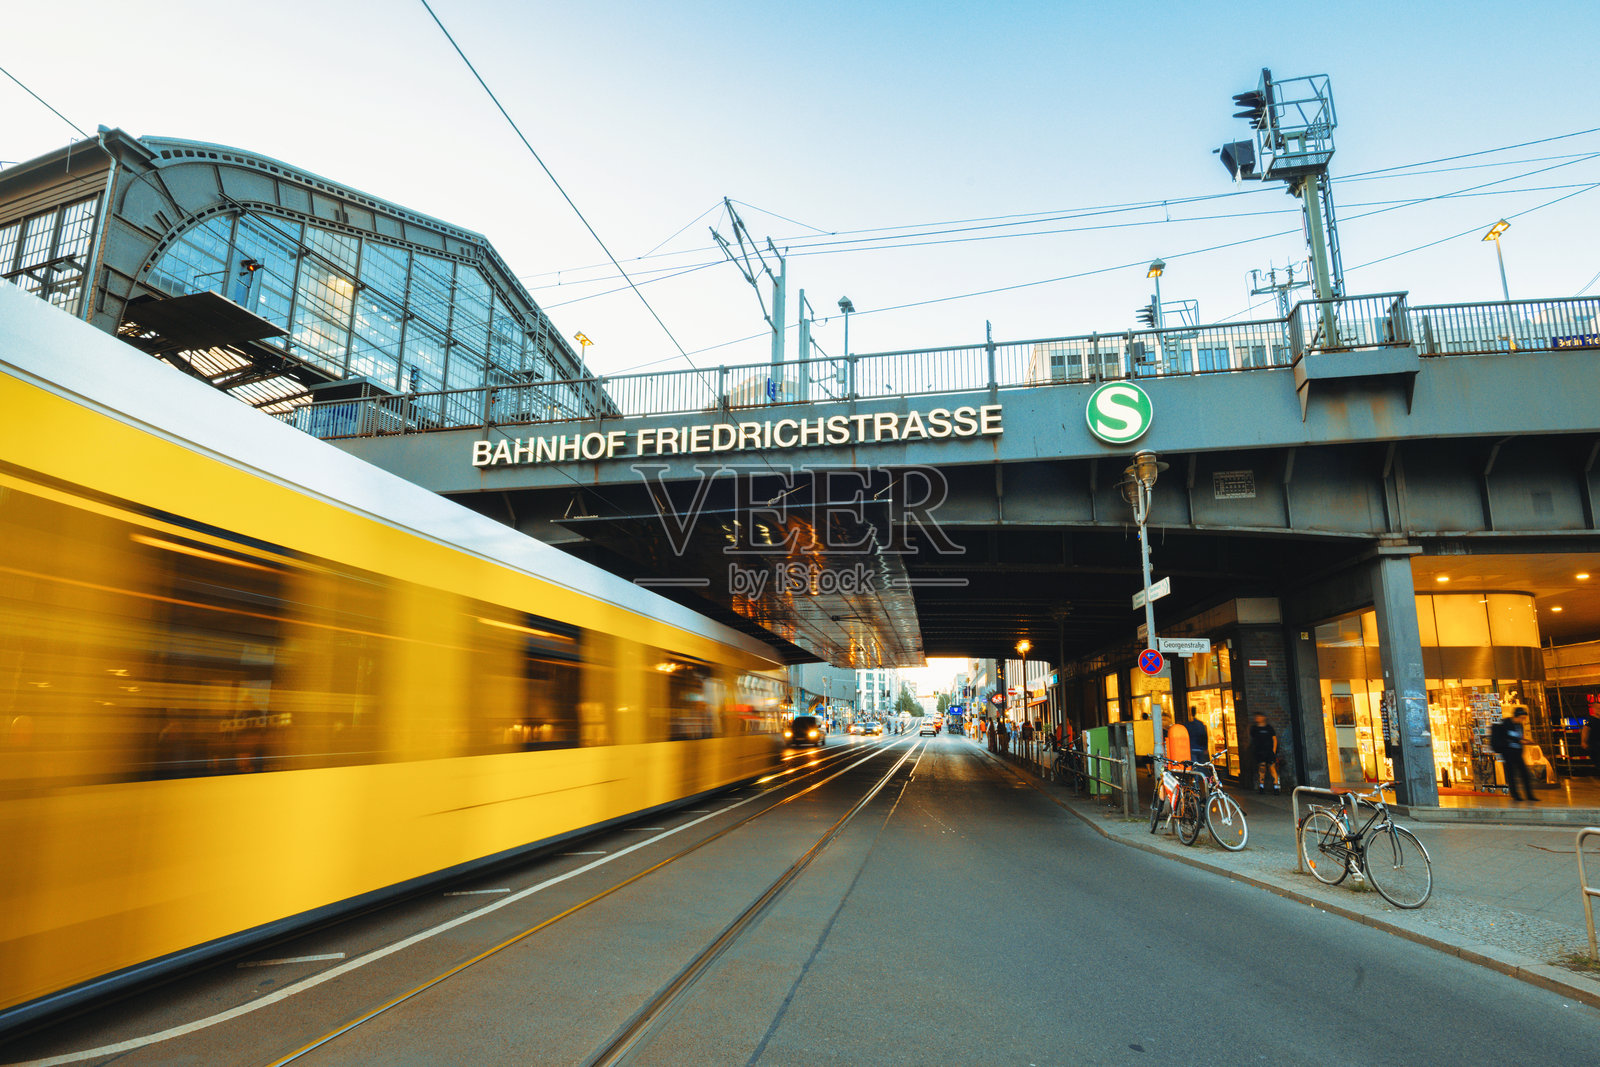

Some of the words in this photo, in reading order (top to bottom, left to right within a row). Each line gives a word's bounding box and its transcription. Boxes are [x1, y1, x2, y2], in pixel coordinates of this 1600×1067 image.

[1559, 338, 1583, 348] Berin
[1096, 386, 1143, 438] S
[472, 430, 627, 467] BAHNHOF
[637, 404, 1004, 456] FRIEDRICHSTRASSE
[1163, 640, 1206, 650] Georgenstraße
